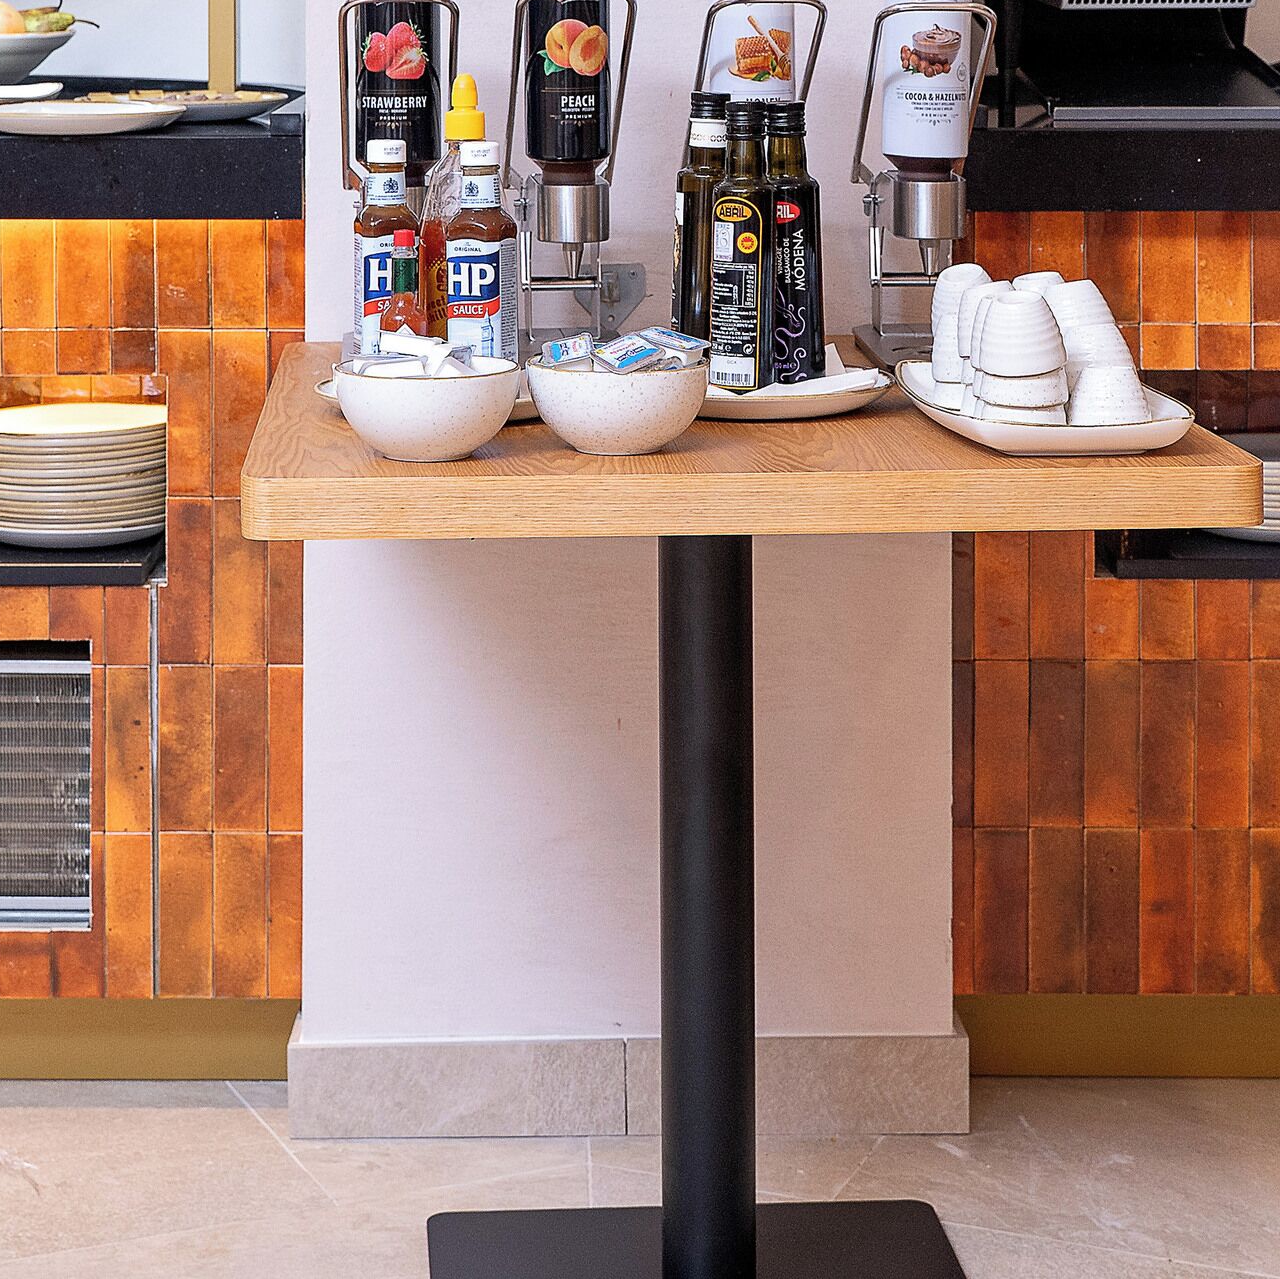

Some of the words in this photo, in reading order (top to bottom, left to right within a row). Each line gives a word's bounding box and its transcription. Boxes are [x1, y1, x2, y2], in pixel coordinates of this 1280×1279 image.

[362, 95, 427, 109] STRAWBERRY
[561, 94, 595, 108] PEACH
[904, 92, 928, 101] COCOA
[928, 93, 934, 101] &
[718, 205, 747, 218] ABRIL
[776, 205, 795, 219] RIL
[783, 237, 790, 247] DE
[792, 228, 806, 291] MÓDENA
[368, 258, 393, 291] H
[447, 262, 495, 297] HP
[453, 305, 483, 315] SAUCE
